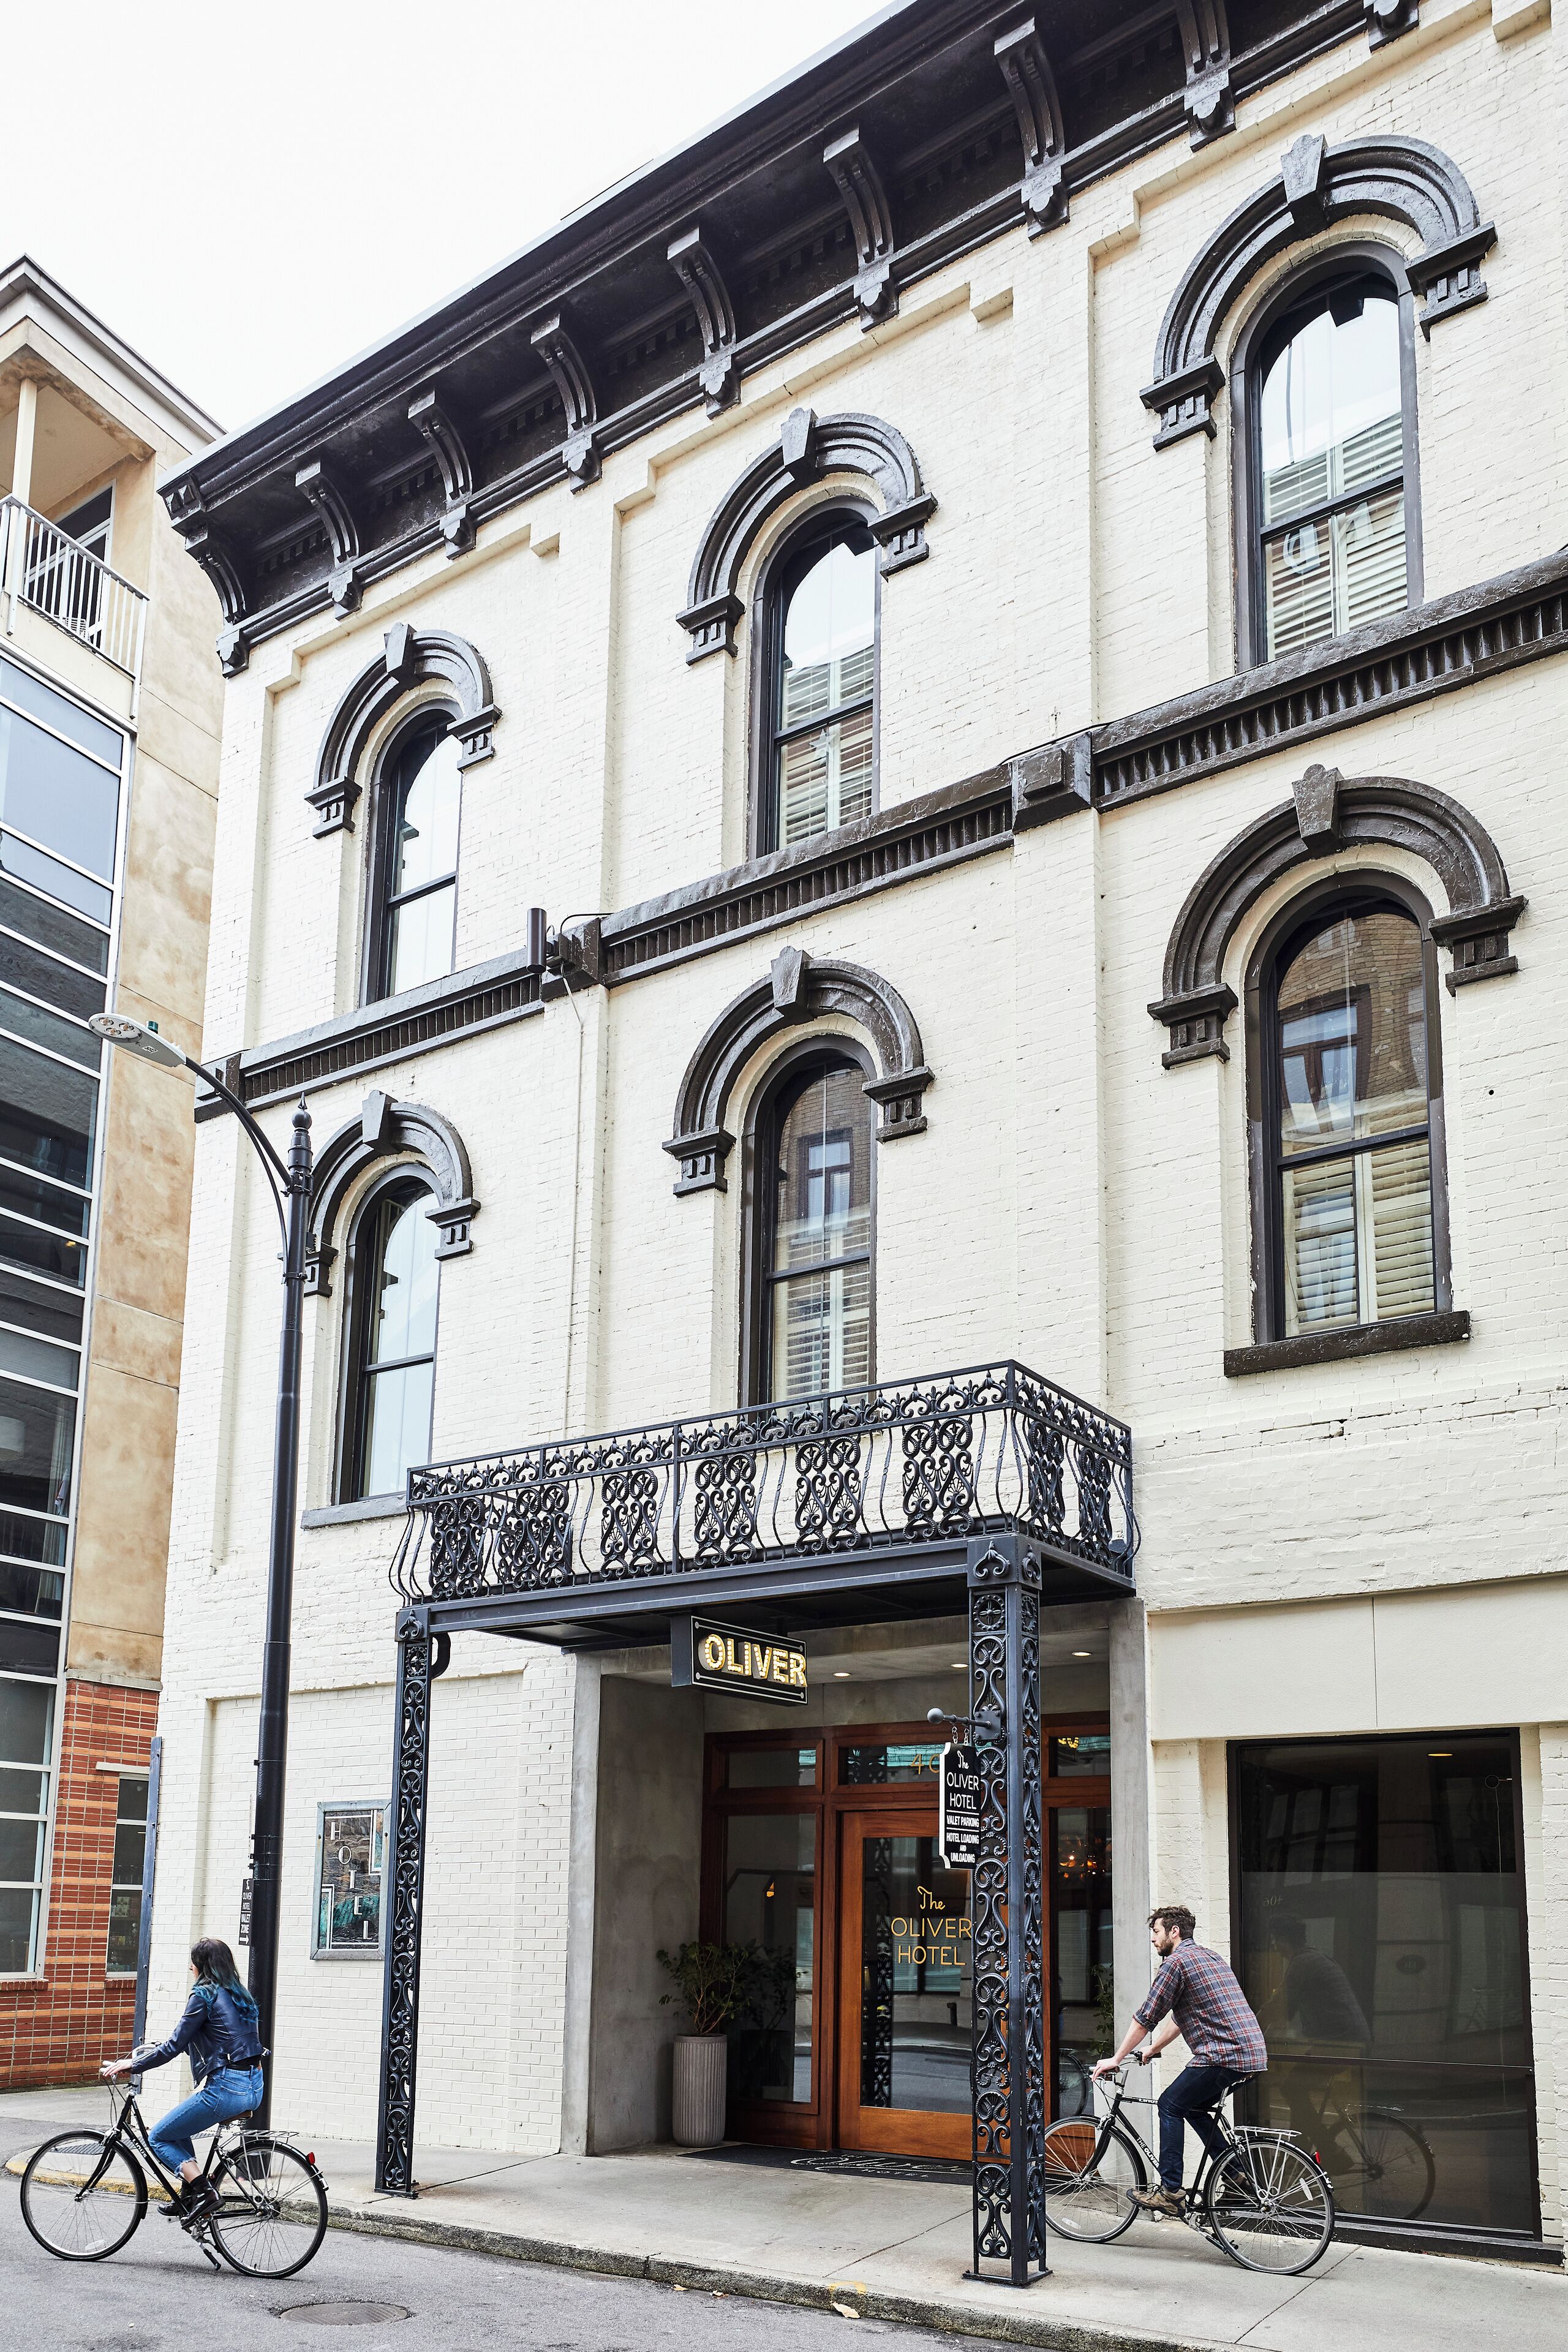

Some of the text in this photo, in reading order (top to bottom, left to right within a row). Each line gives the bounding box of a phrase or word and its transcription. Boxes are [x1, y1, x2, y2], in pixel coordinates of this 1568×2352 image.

[699, 1634, 808, 1687] OLIVER
[957, 1750, 970, 1770] The
[946, 1771, 979, 1791] OLIVER
[949, 1792, 977, 1810] HOTEL
[946, 1815, 979, 1828] VALET PARKING
[946, 1832, 979, 1844] HOTEL LOADING
[950, 1852, 975, 1863] UNLOADING
[917, 1885, 946, 1910] The
[241, 1913, 251, 1923] VALET
[241, 1924, 249, 1933] ZONE
[891, 1917, 972, 1939] OLIVER
[897, 1945, 967, 1966] HOTEL
[1136, 2137, 1159, 2168] THE OLIVER
[861, 2168, 929, 2178] HOTEL
